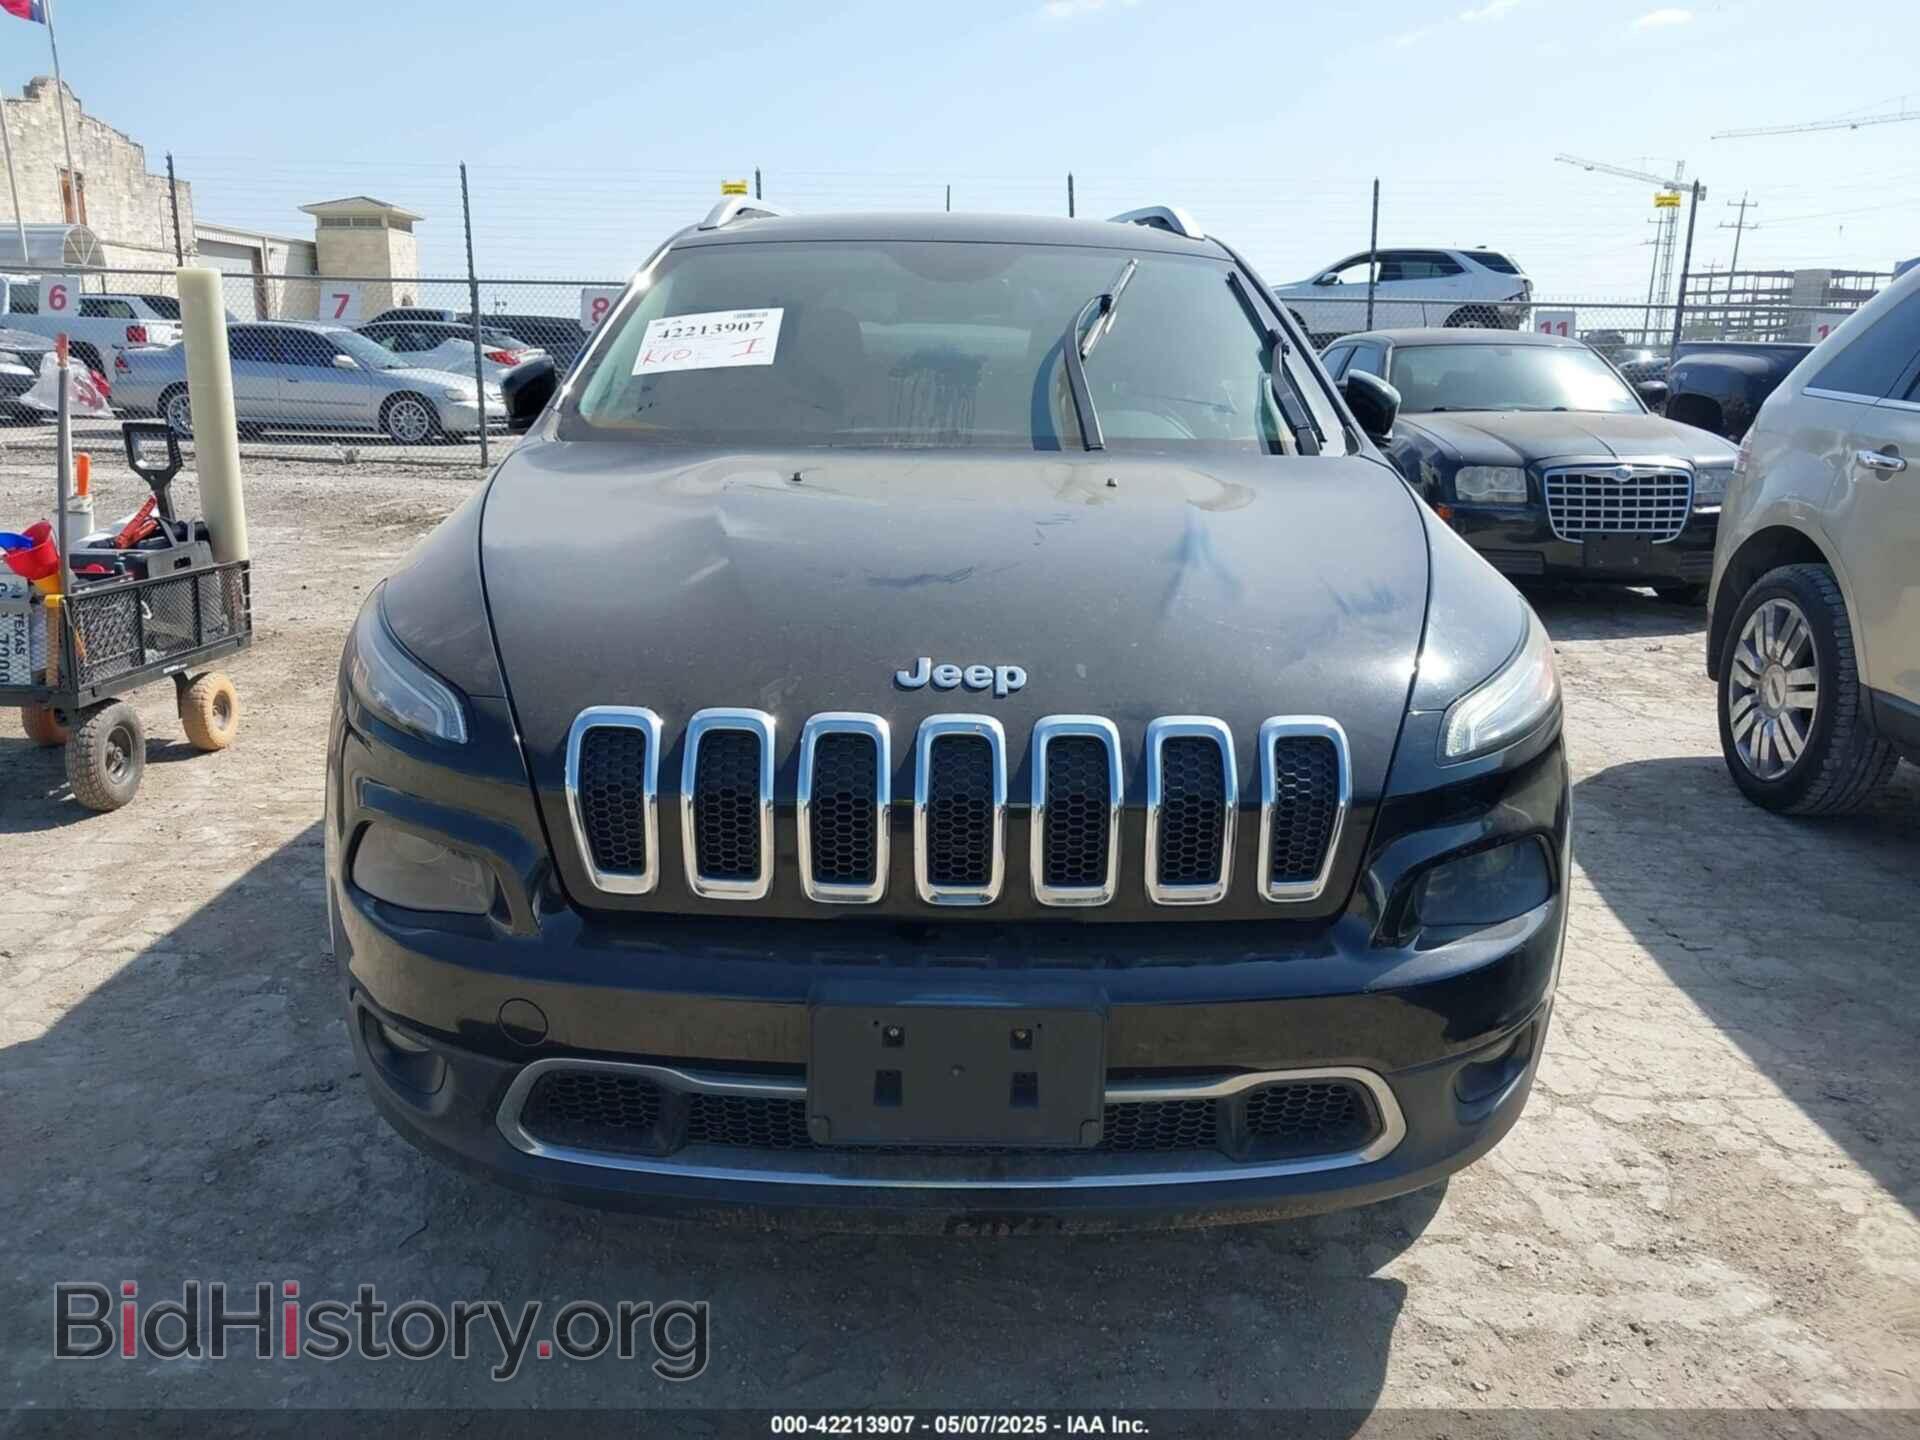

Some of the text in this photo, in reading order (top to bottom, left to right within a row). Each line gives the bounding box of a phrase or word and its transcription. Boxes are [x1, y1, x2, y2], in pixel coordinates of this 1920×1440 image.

[49, 284, 67, 311] 6
[332, 293, 350, 319] 7
[657, 320, 765, 339] 42213907
[14, 612, 26, 656] TEXAS
[895, 656, 1027, 697] Jeep
